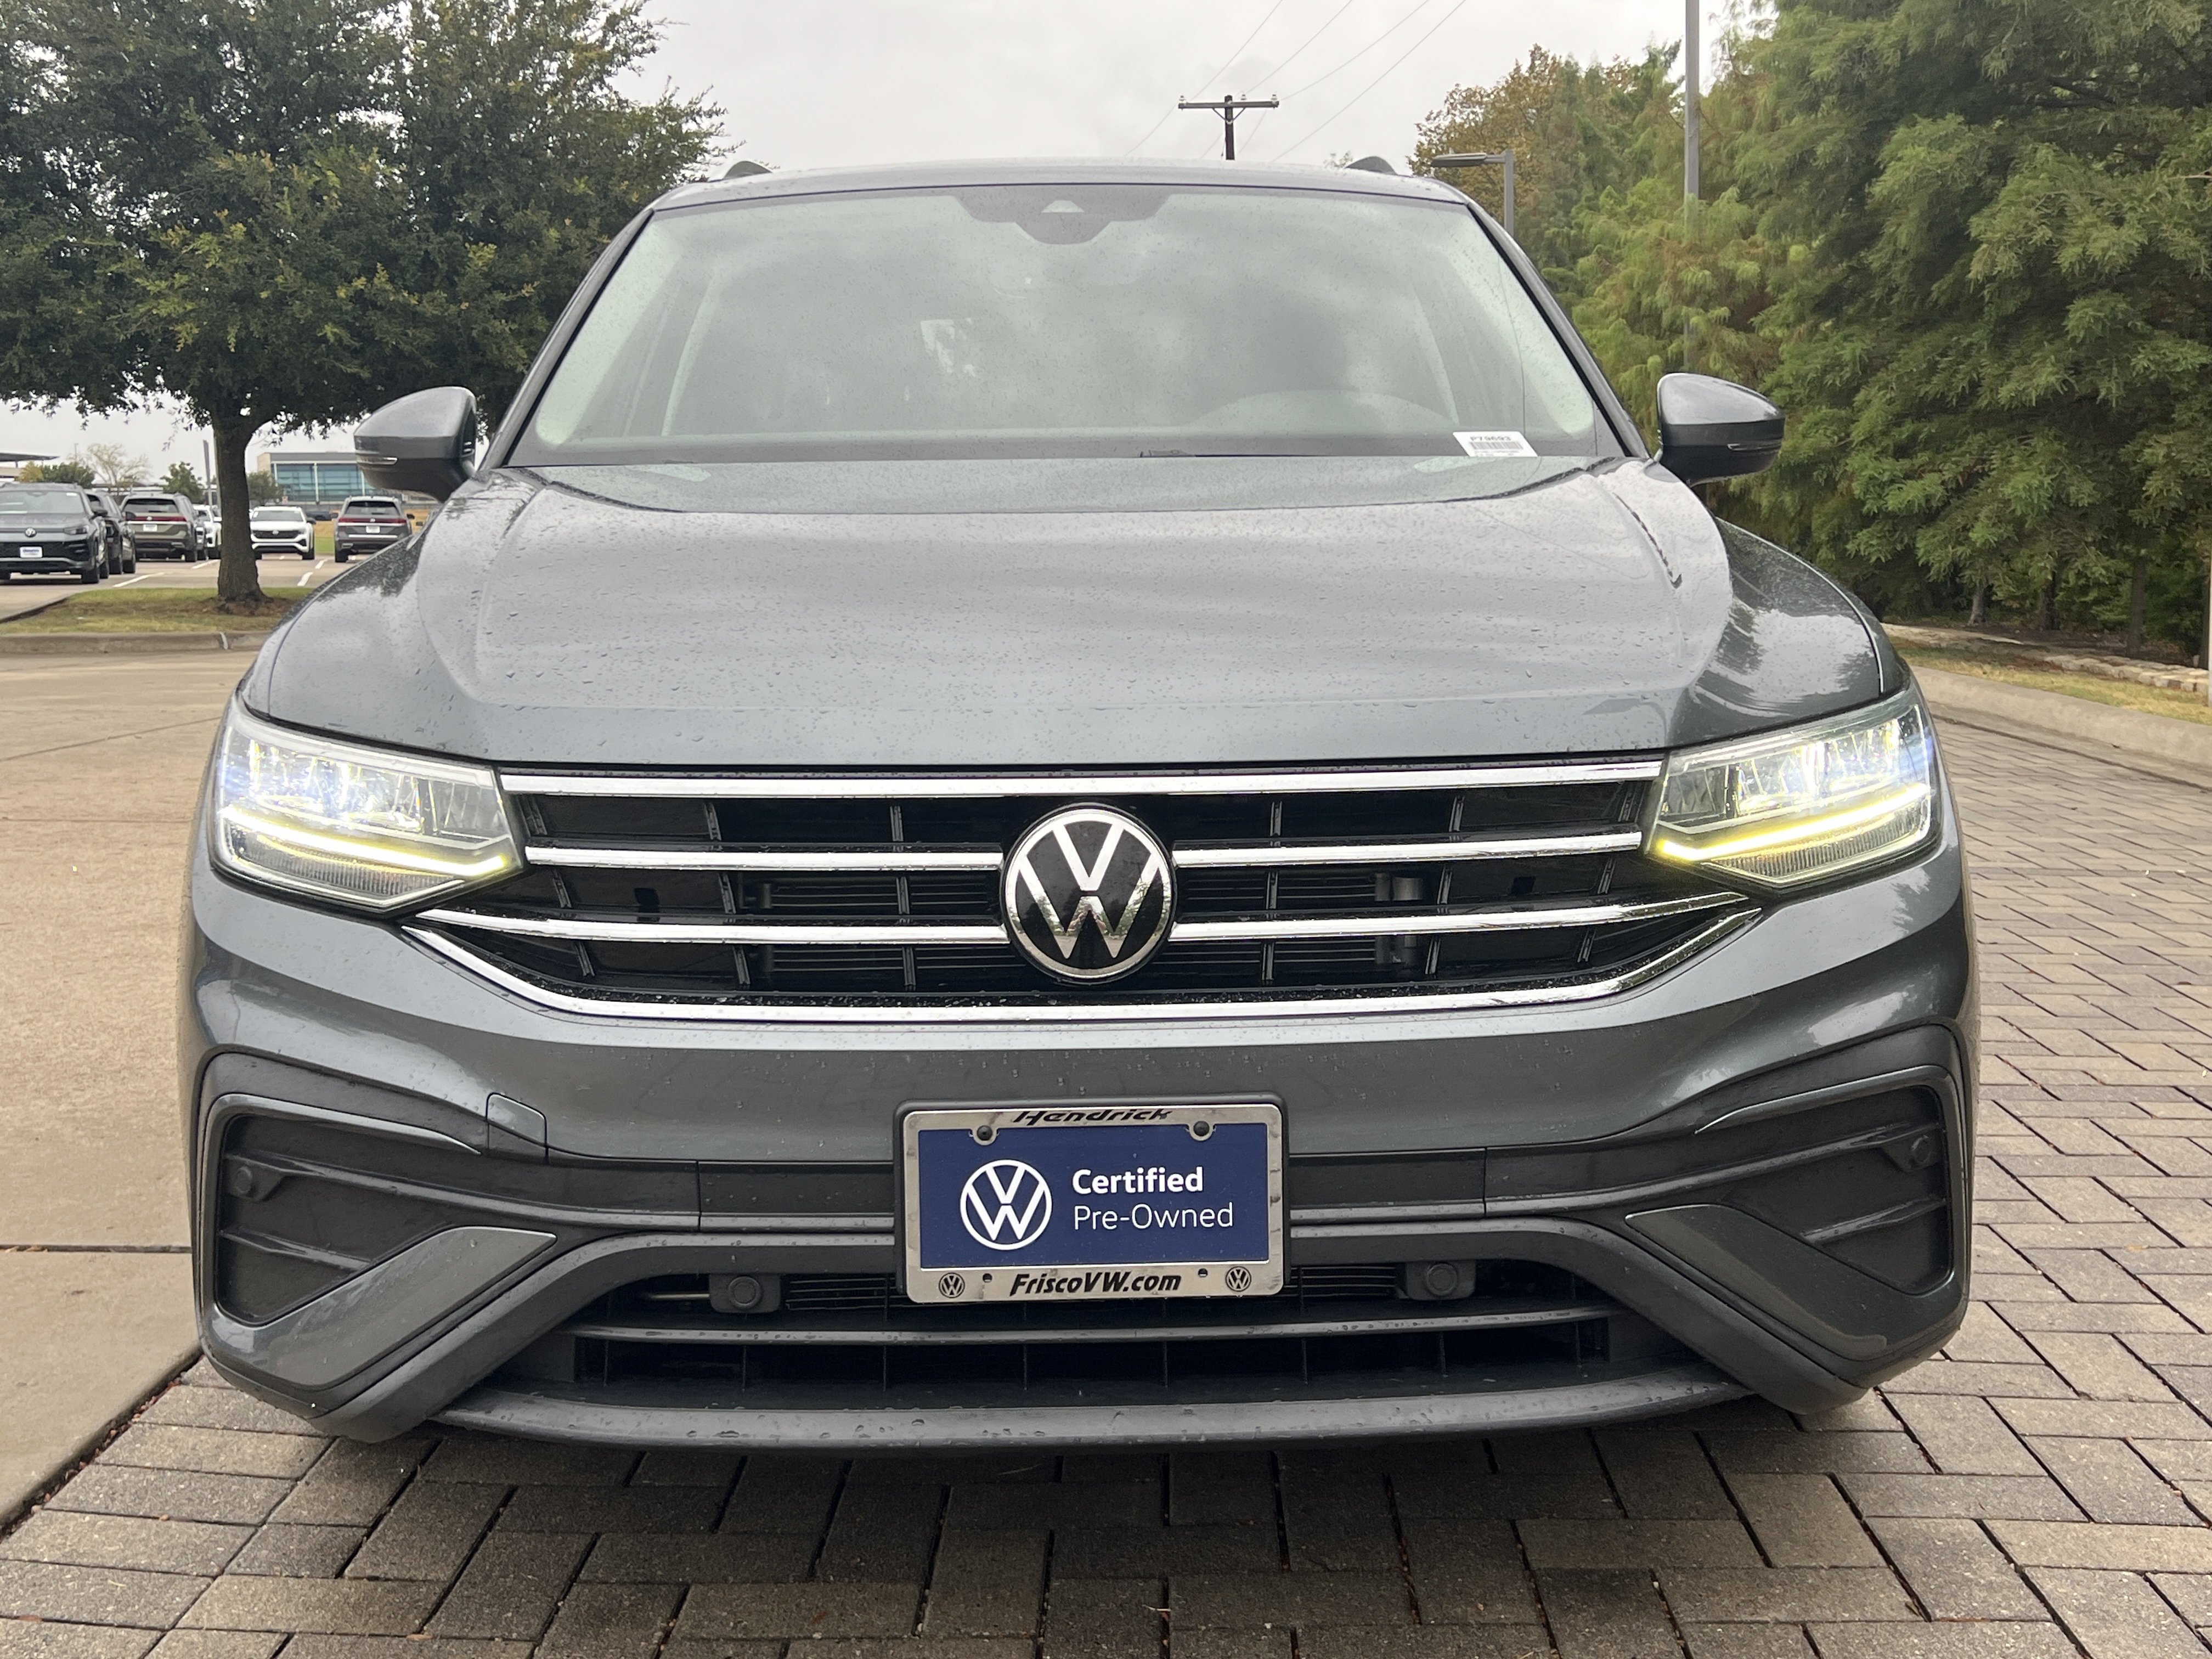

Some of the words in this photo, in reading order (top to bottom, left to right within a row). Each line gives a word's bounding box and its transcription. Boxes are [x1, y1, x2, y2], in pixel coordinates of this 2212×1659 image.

[1013, 1108, 1172, 1126] Hendrick
[1073, 1166, 1203, 1194] Certified
[961, 1160, 1052, 1250] VW
[1074, 1201, 1233, 1230] Pre-Owned
[1009, 1272, 1182, 1296] FriscoVW.com
